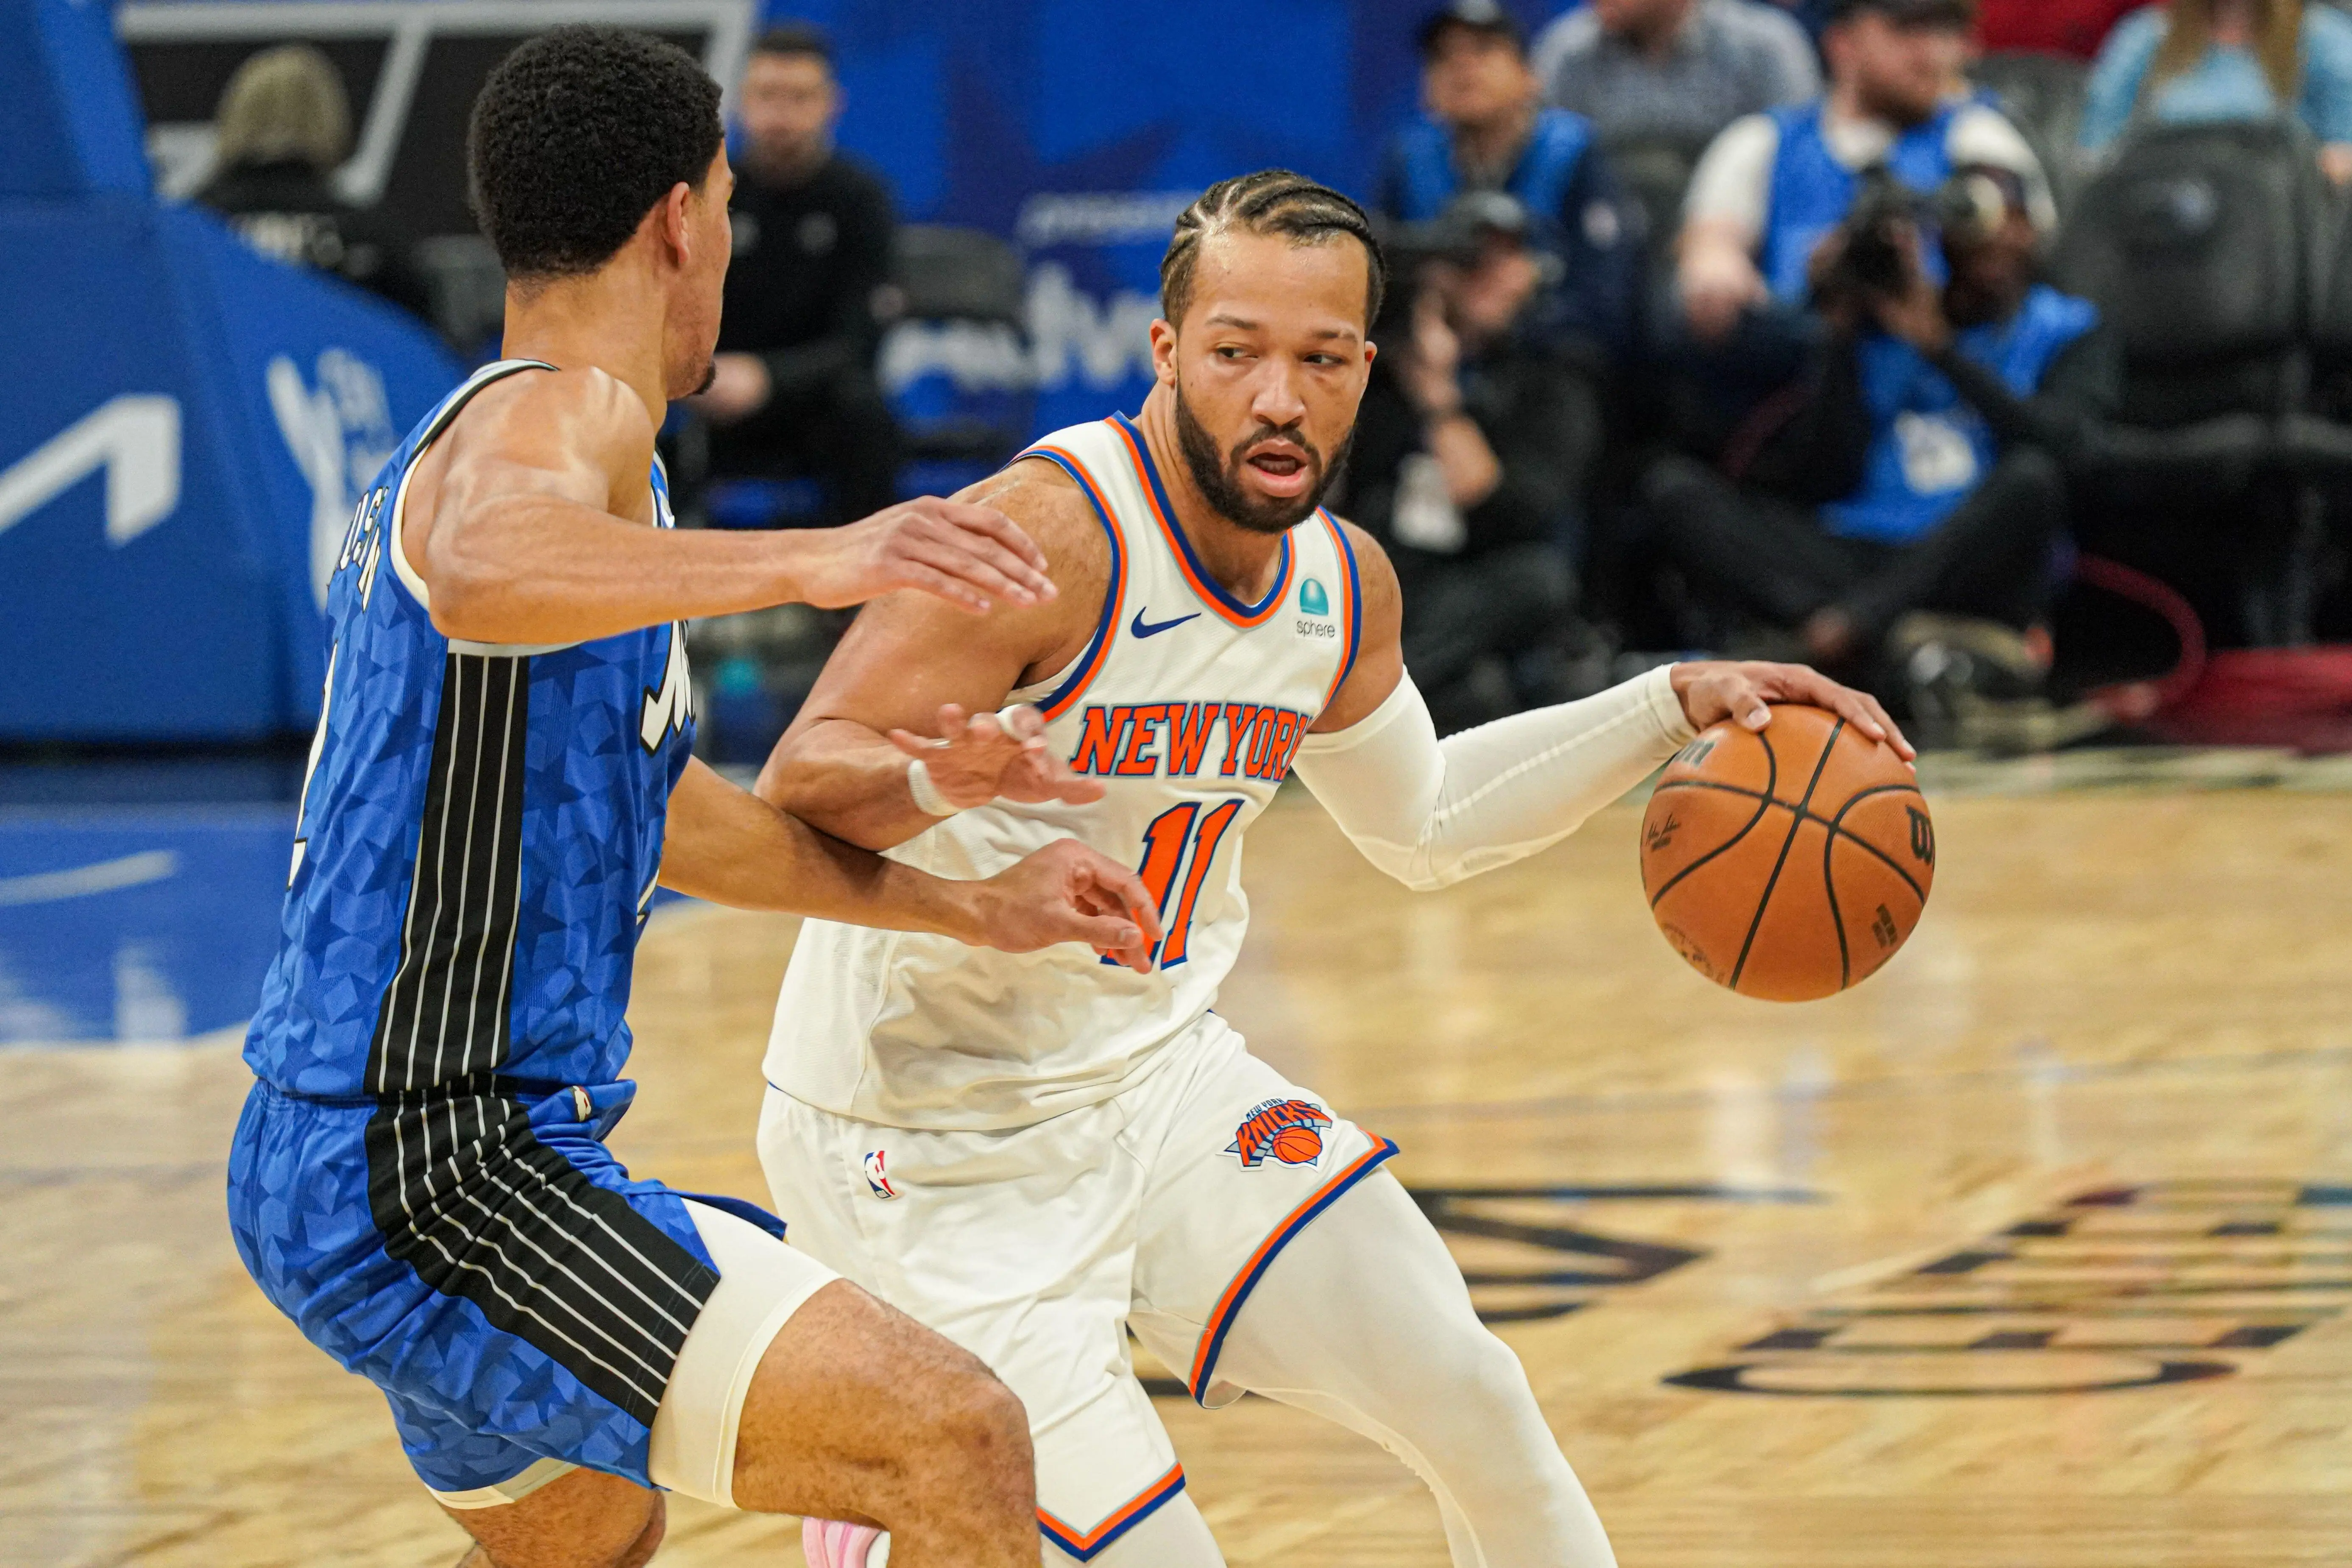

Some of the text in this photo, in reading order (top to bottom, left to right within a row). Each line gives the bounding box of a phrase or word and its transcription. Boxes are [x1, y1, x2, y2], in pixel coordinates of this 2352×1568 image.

[1296, 619, 1335, 638] sphere
[1070, 702, 1221, 776] NEW
[1099, 799, 1246, 971] 11
[1236, 1100, 1333, 1167] KNICKS
[1246, 1098, 1287, 1122] NEW YORK
